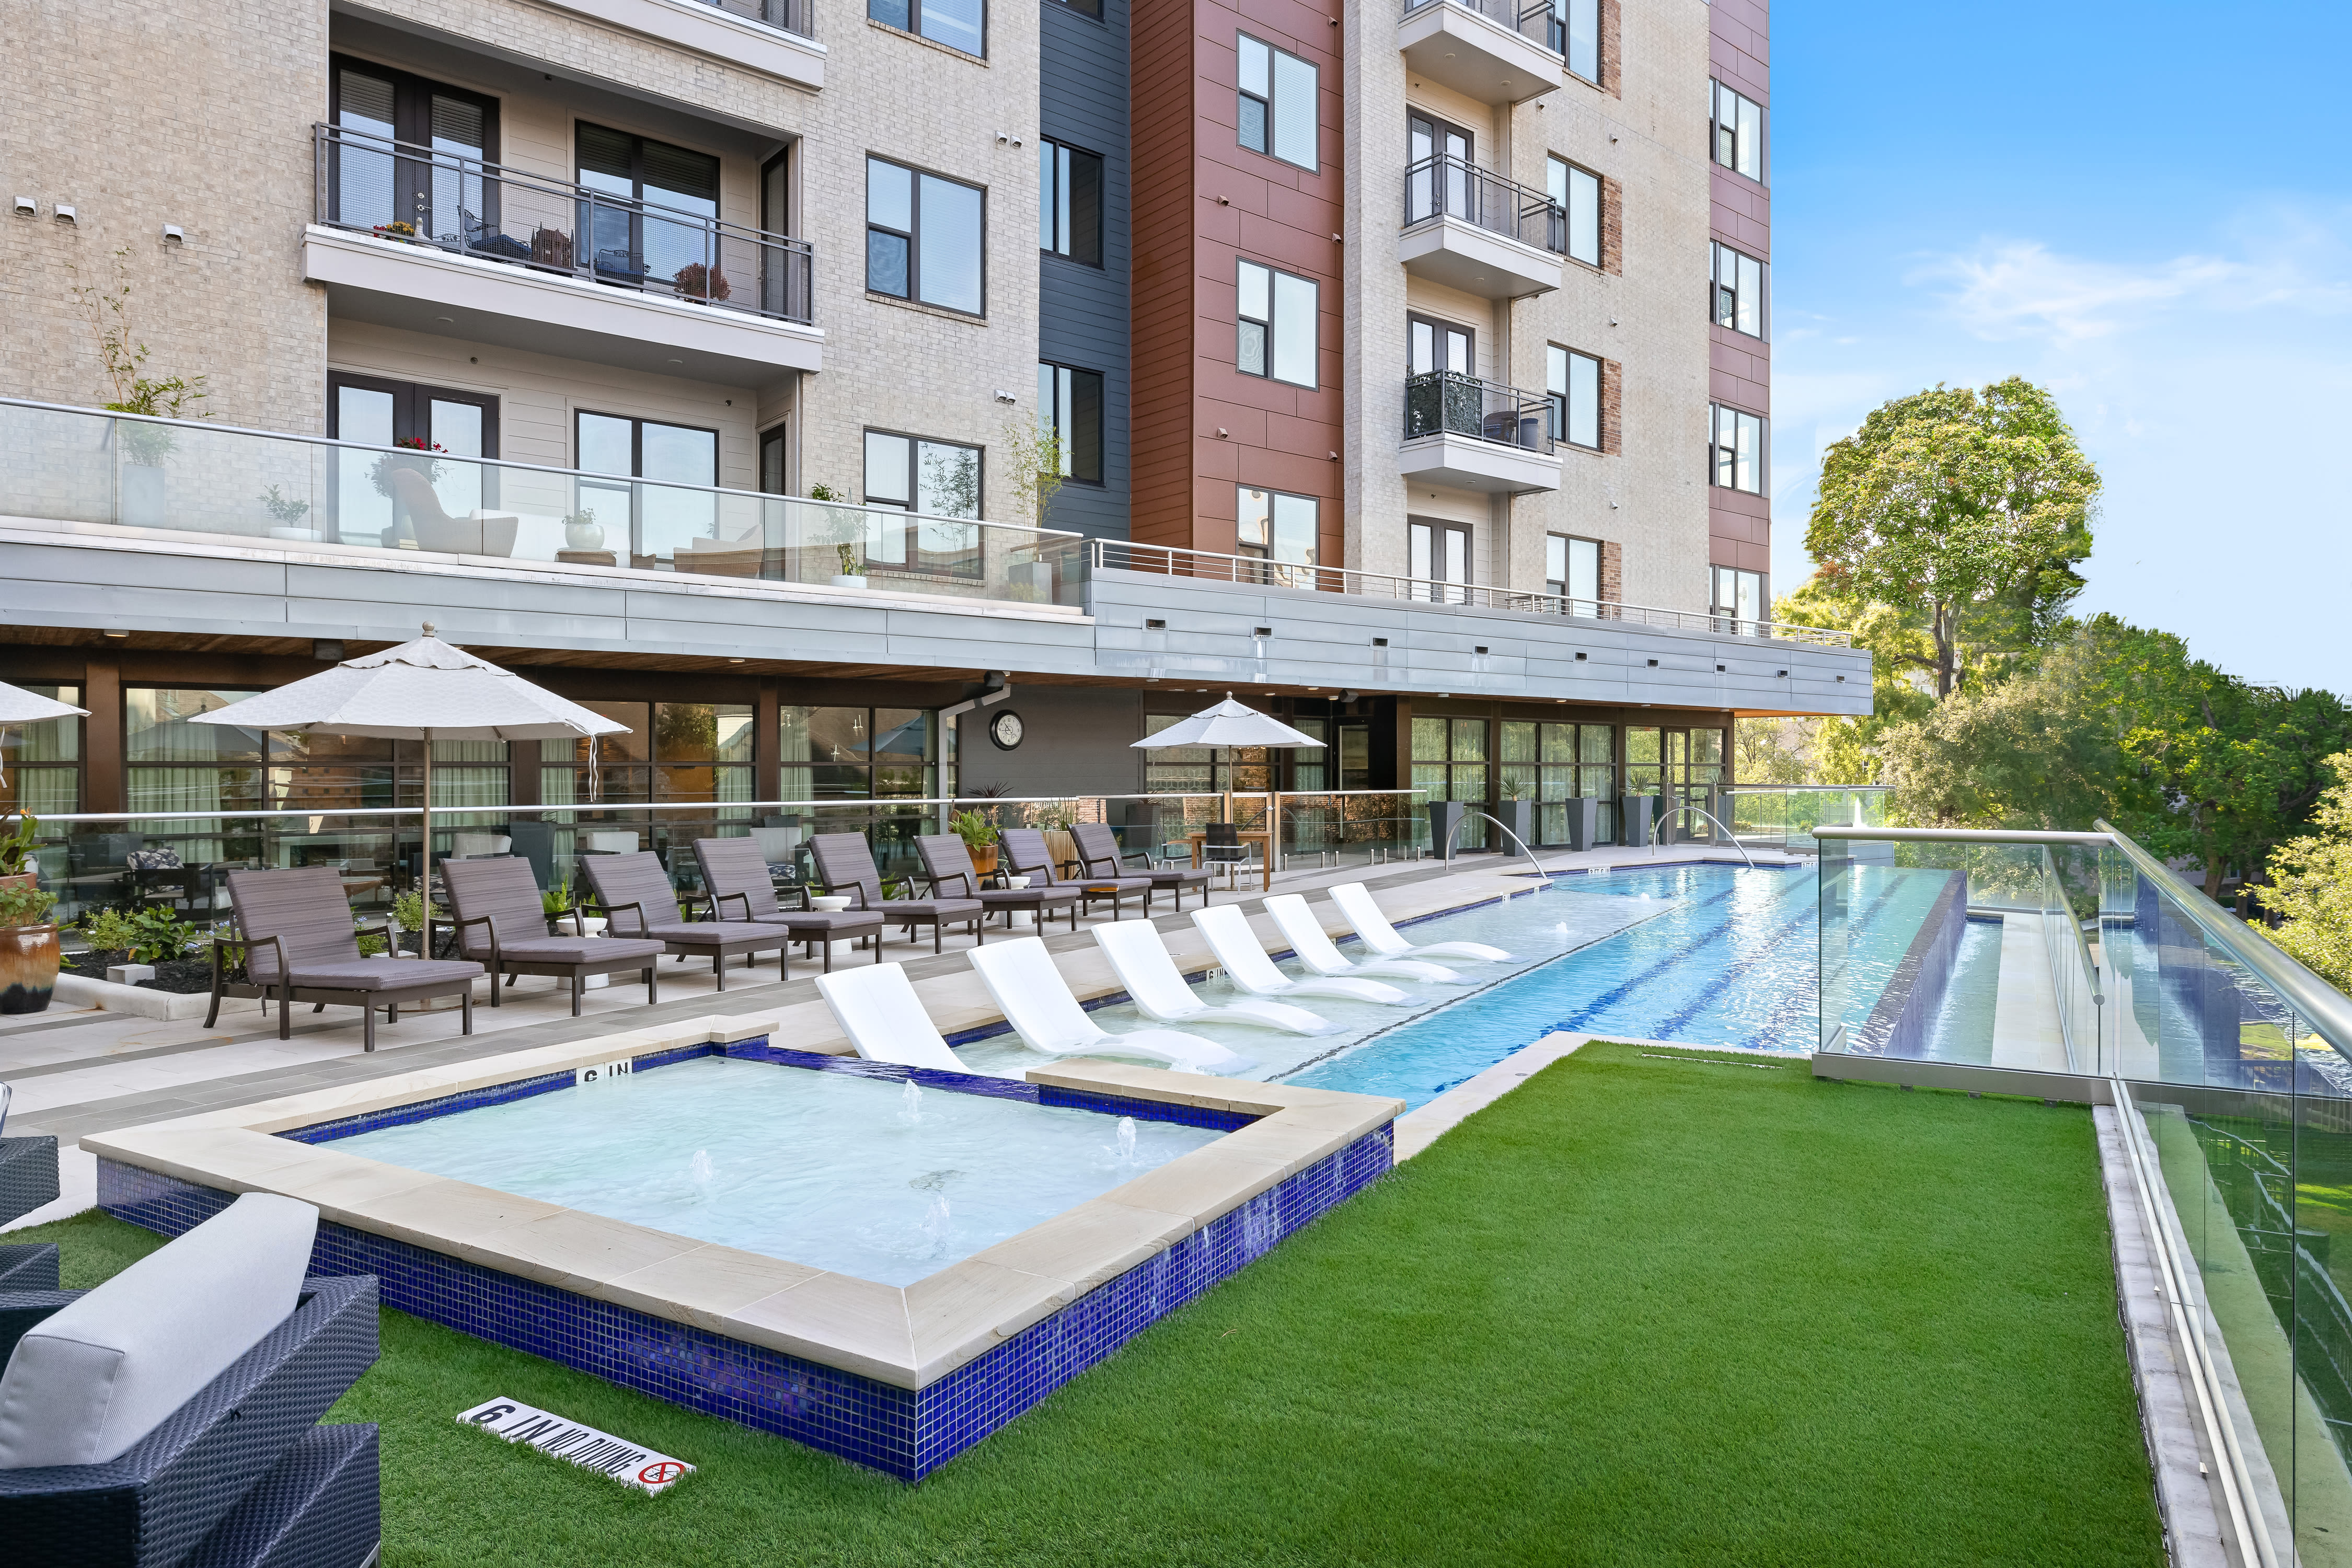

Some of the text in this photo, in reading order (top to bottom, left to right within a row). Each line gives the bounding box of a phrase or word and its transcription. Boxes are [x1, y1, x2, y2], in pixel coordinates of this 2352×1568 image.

[1217, 967, 1224, 977] IN
[609, 1062, 628, 1077] IN
[471, 1404, 564, 1442] 6 IN
[537, 1428, 647, 1475] NO DIVING
